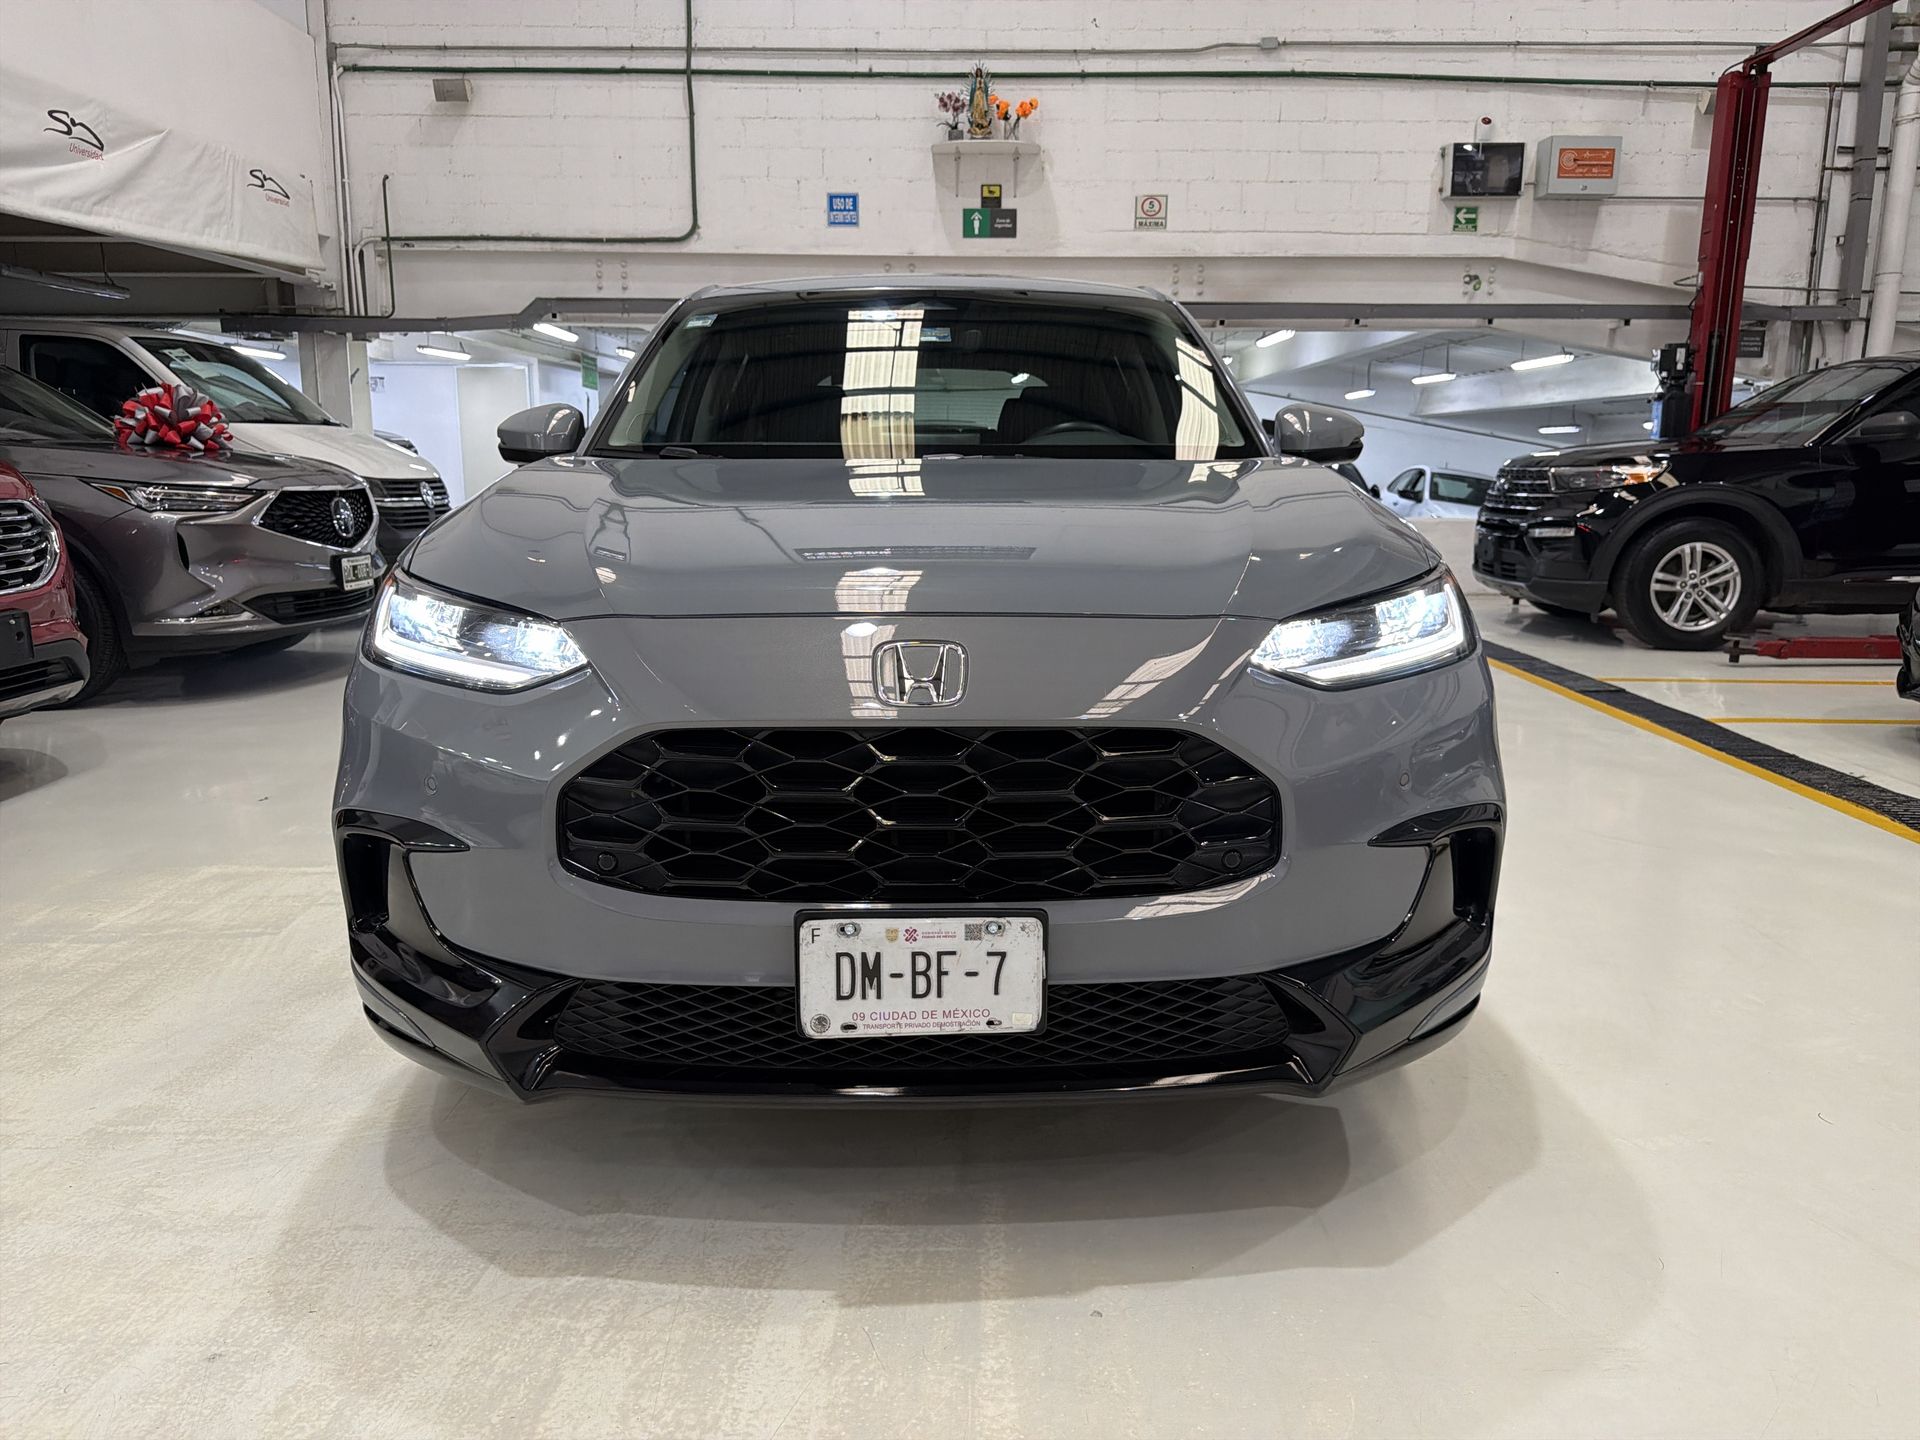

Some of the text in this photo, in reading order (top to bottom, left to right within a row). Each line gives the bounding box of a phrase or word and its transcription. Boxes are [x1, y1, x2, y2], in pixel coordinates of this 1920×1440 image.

[832, 197, 854, 210] USO DE
[1148, 200, 1155, 209] 5
[1138, 219, 1164, 227] MÁXIMA
[811, 927, 821, 944] F
[836, 951, 1007, 1001] DM-BF-7
[851, 1008, 991, 1022] 09 CIUDAD DE MÉXICO
[863, 1022, 903, 1030] TRANSPORTE
[932, 1020, 981, 1029] DEMOSTRACIÓN
